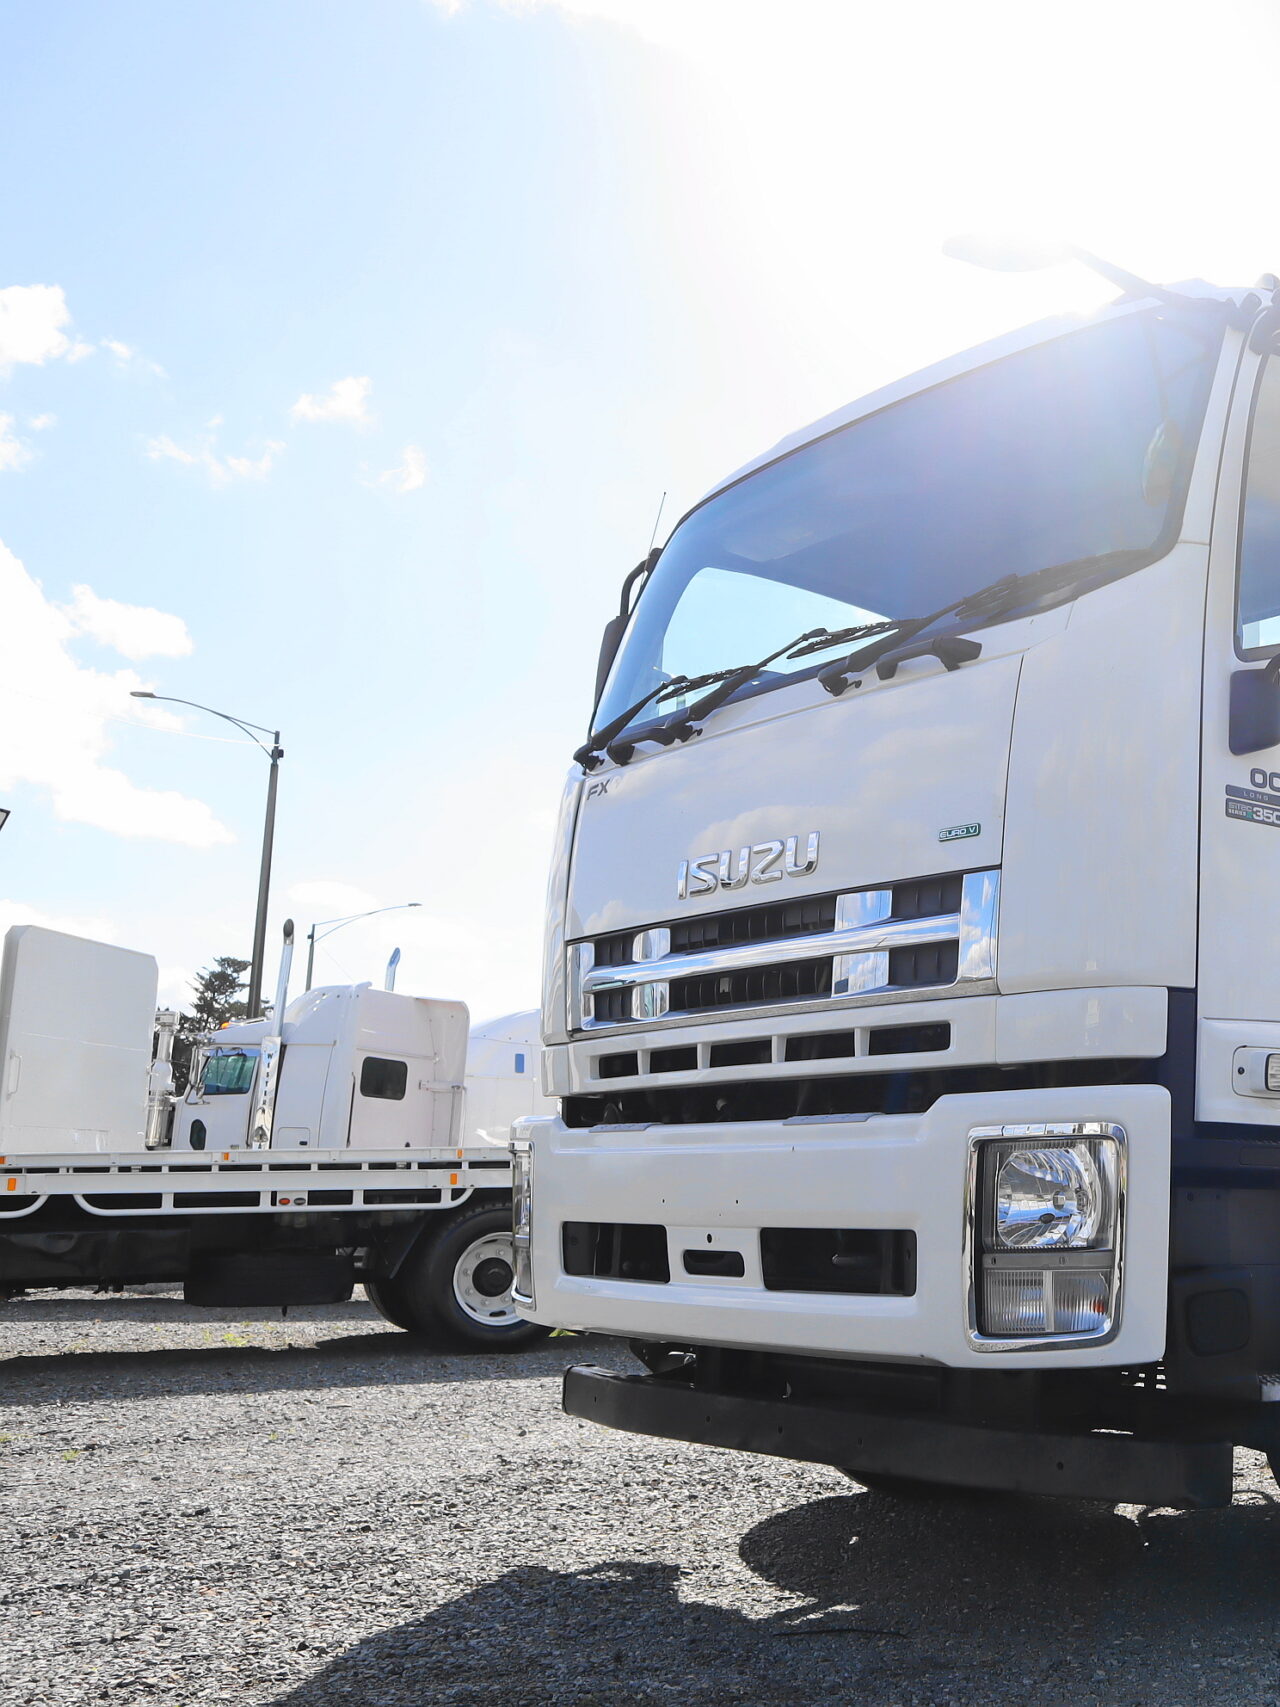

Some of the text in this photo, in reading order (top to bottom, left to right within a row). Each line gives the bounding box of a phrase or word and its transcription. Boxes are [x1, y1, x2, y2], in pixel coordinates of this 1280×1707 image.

[586, 778, 611, 801] FX
[1243, 791, 1269, 801] LONG
[939, 828, 967, 839] EURO
[677, 830, 820, 900] ISUZU
